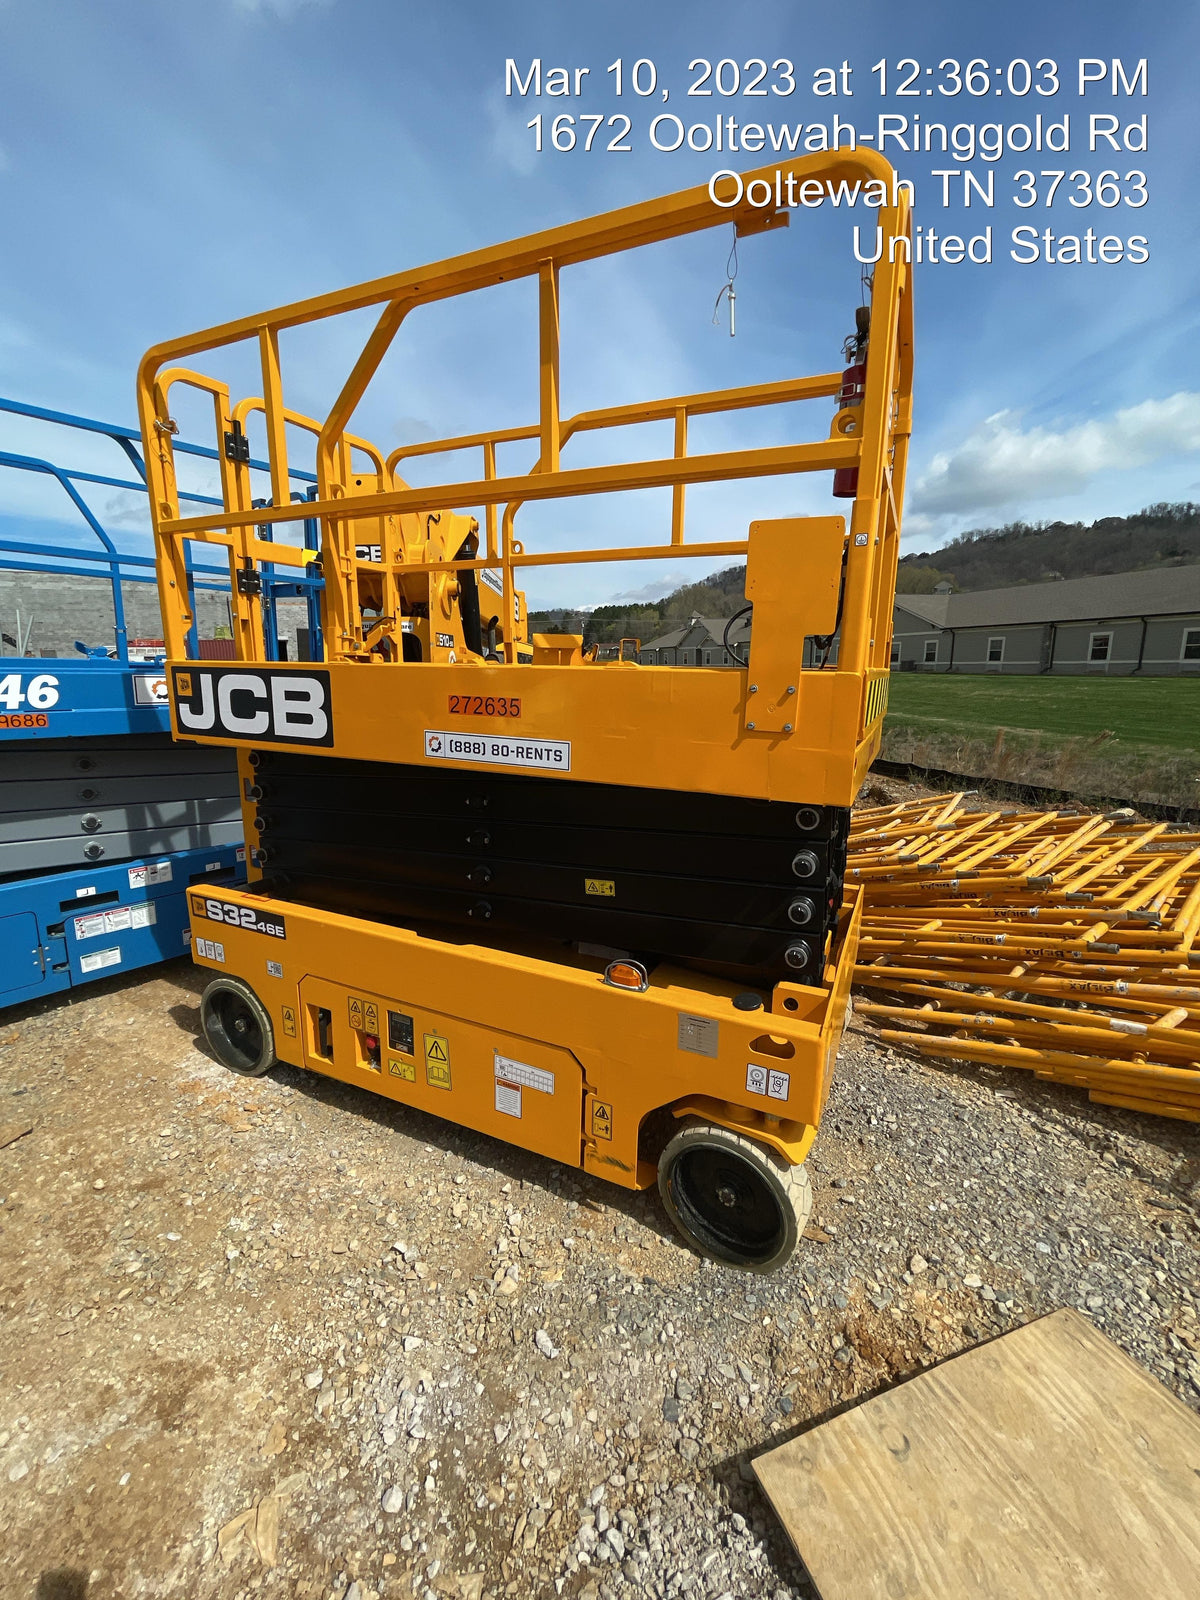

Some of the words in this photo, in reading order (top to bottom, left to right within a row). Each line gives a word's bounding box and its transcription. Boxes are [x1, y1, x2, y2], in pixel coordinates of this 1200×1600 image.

[0, 674, 59, 709] 46
[179, 673, 328, 739] JCB
[449, 695, 520, 717] 272635
[449, 739, 486, 756] (888)
[491, 744, 563, 762] 80-RENTS
